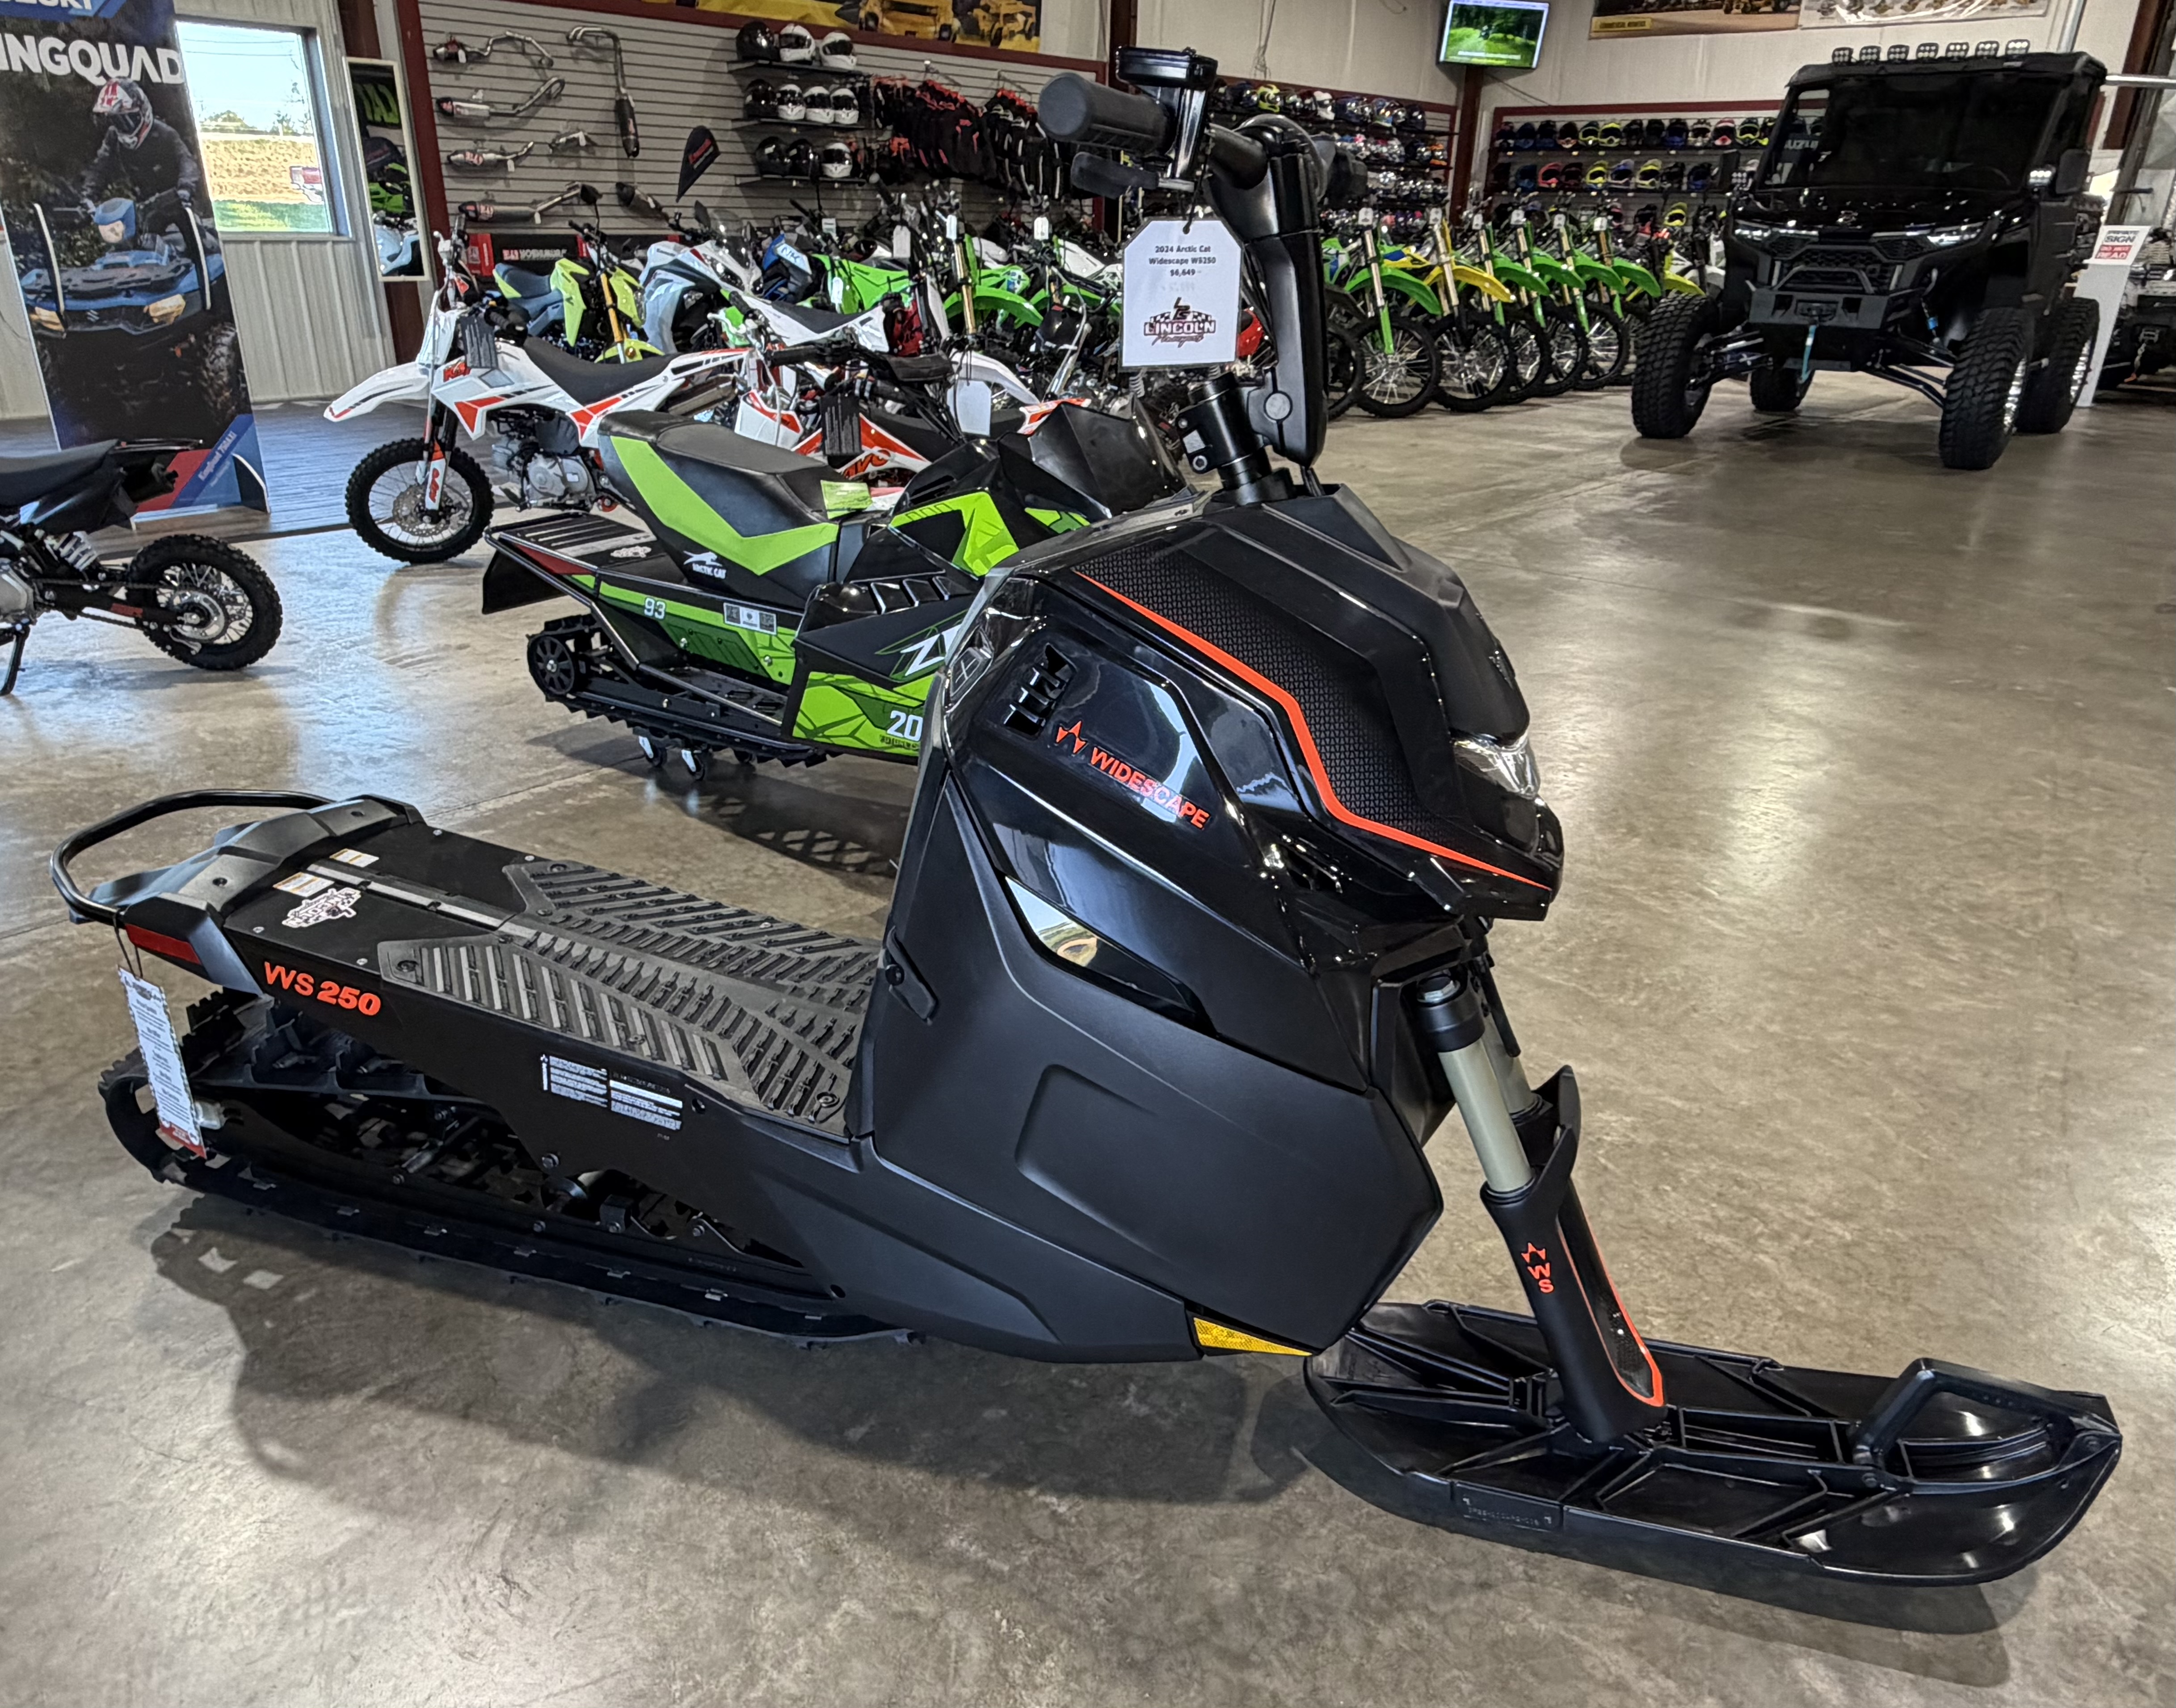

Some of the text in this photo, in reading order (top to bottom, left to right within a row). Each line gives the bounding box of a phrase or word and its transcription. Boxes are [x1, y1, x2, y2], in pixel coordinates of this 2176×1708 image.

[1149, 257, 1189, 265] Widescape
[1145, 321, 1215, 335] LINCOLN
[714, 567, 726, 579] CAT
[644, 597, 665, 619] 93
[887, 710, 923, 741] 20
[1090, 747, 1210, 829] WIDESCAPE
[264, 961, 381, 1016] WS 250
[1527, 1262, 1554, 1293] WS
